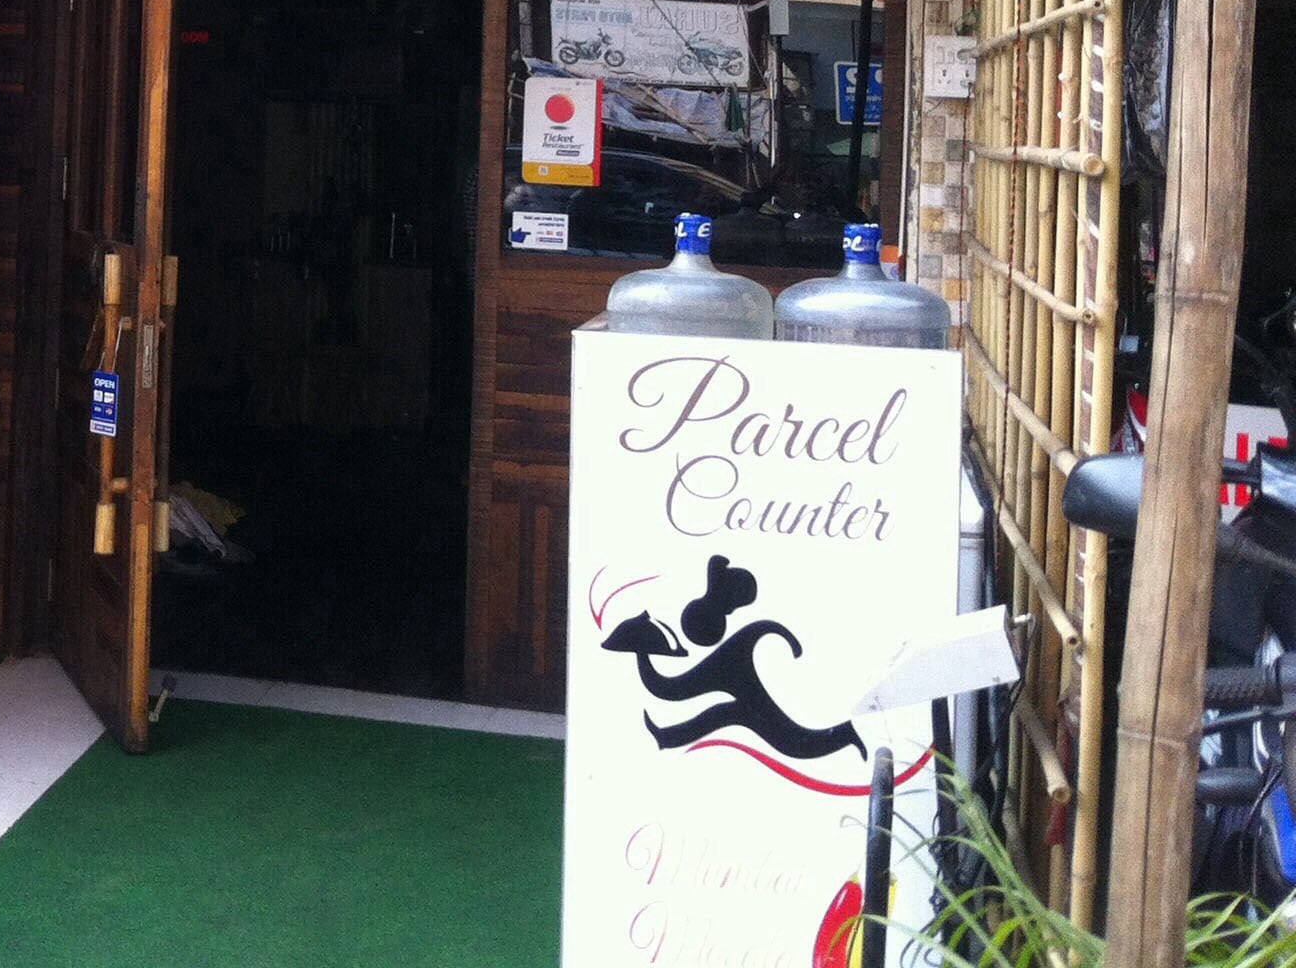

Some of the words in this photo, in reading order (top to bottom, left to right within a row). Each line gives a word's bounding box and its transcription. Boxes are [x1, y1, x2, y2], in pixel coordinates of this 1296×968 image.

[543, 133, 574, 144] Ticket
[619, 354, 908, 465] Parcel
[665, 453, 893, 541] Counter
